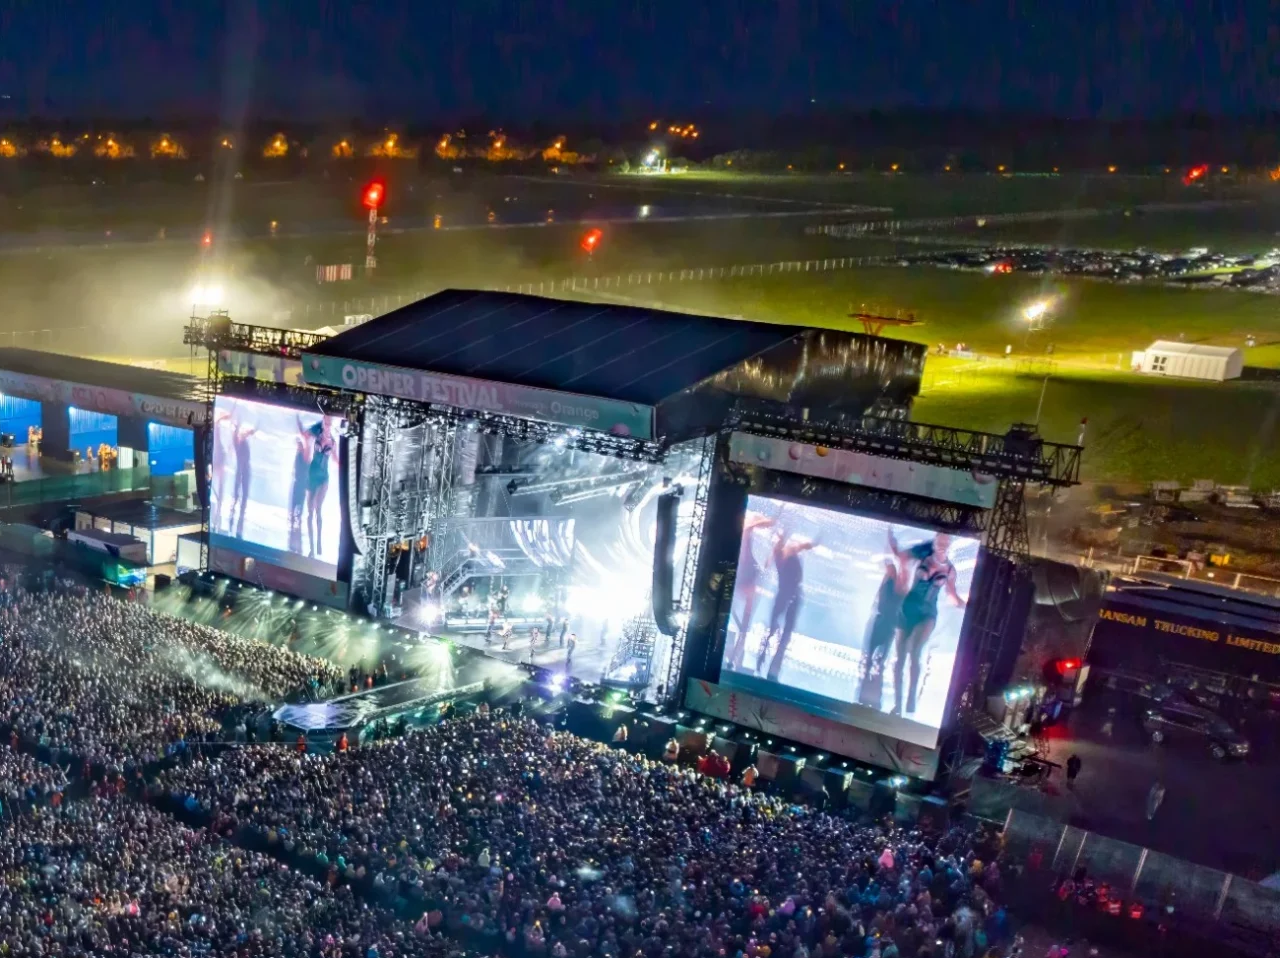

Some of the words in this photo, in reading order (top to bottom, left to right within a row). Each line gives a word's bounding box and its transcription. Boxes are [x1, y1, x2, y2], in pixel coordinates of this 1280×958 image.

[342, 364, 415, 396] OPEN'ER
[420, 375, 504, 410] FESTIVAL
[551, 401, 600, 421] Orange
[1154, 619, 1219, 642] TRUCKING
[1226, 634, 1280, 655] LIMITED
